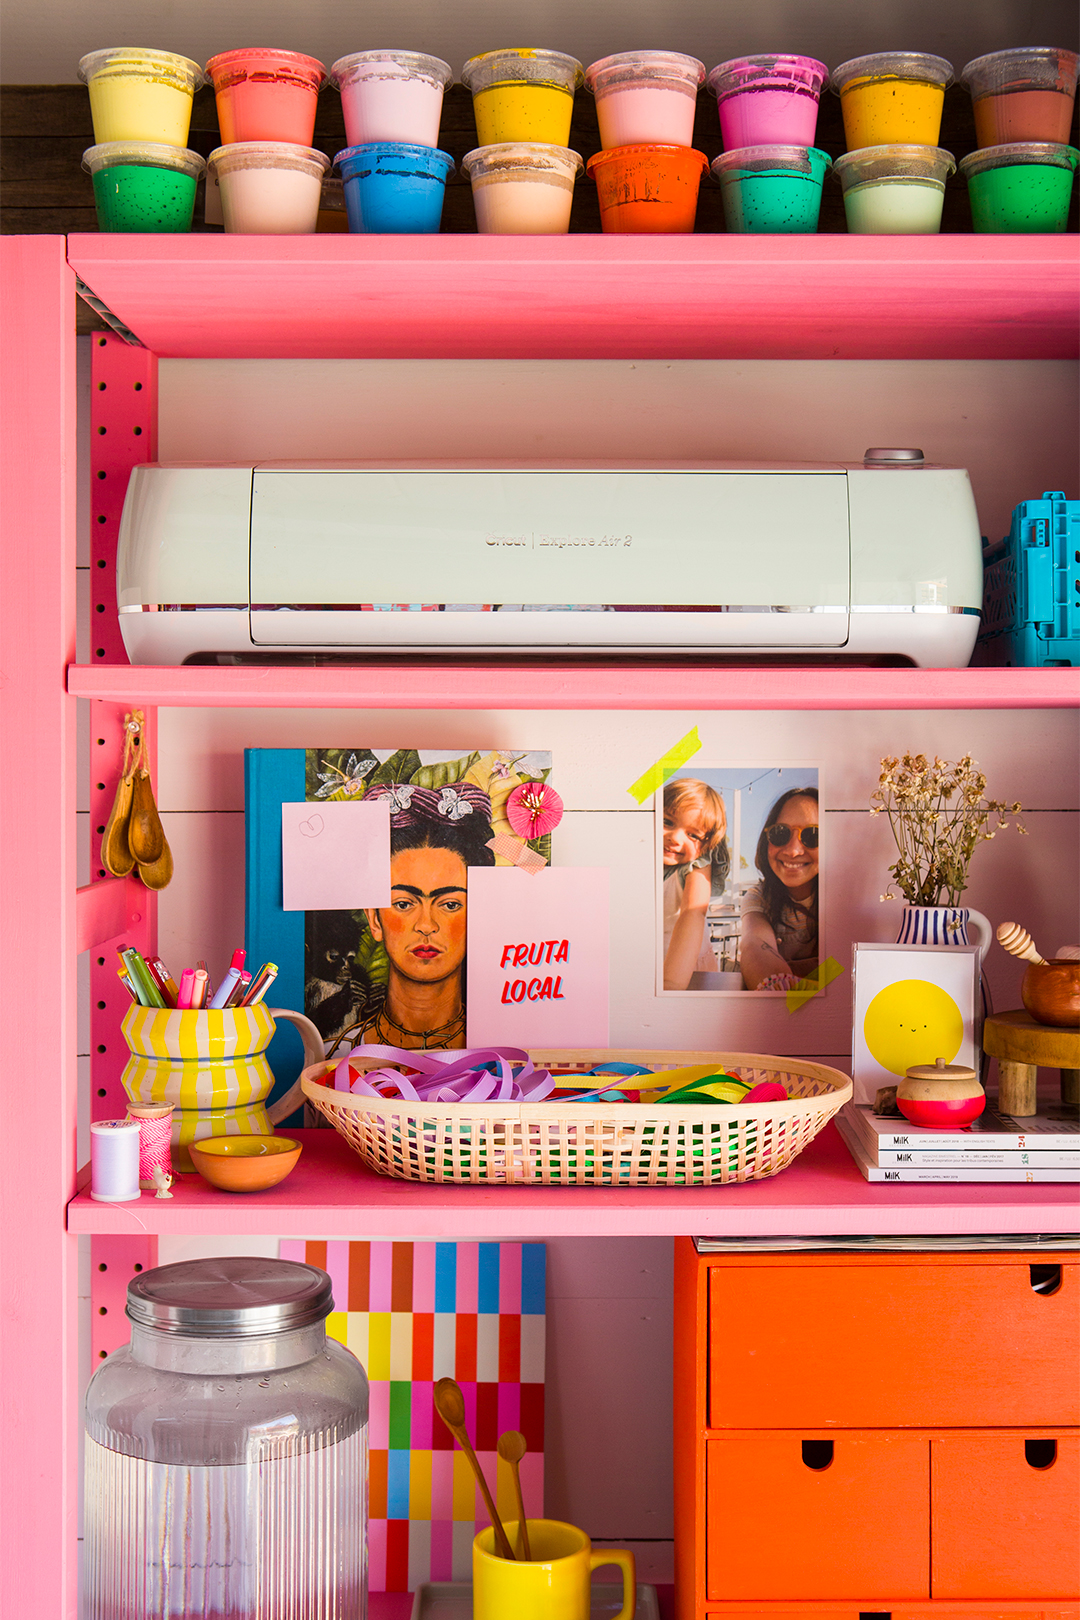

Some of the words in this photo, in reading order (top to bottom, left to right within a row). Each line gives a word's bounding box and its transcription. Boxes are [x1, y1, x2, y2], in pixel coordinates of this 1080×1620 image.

[485, 532, 526, 546] Cricut
[539, 534, 596, 548] Explore
[598, 534, 621, 547] Air
[623, 534, 633, 547] 2
[500, 939, 571, 970] FRUTA
[501, 975, 566, 1006] LOCAL
